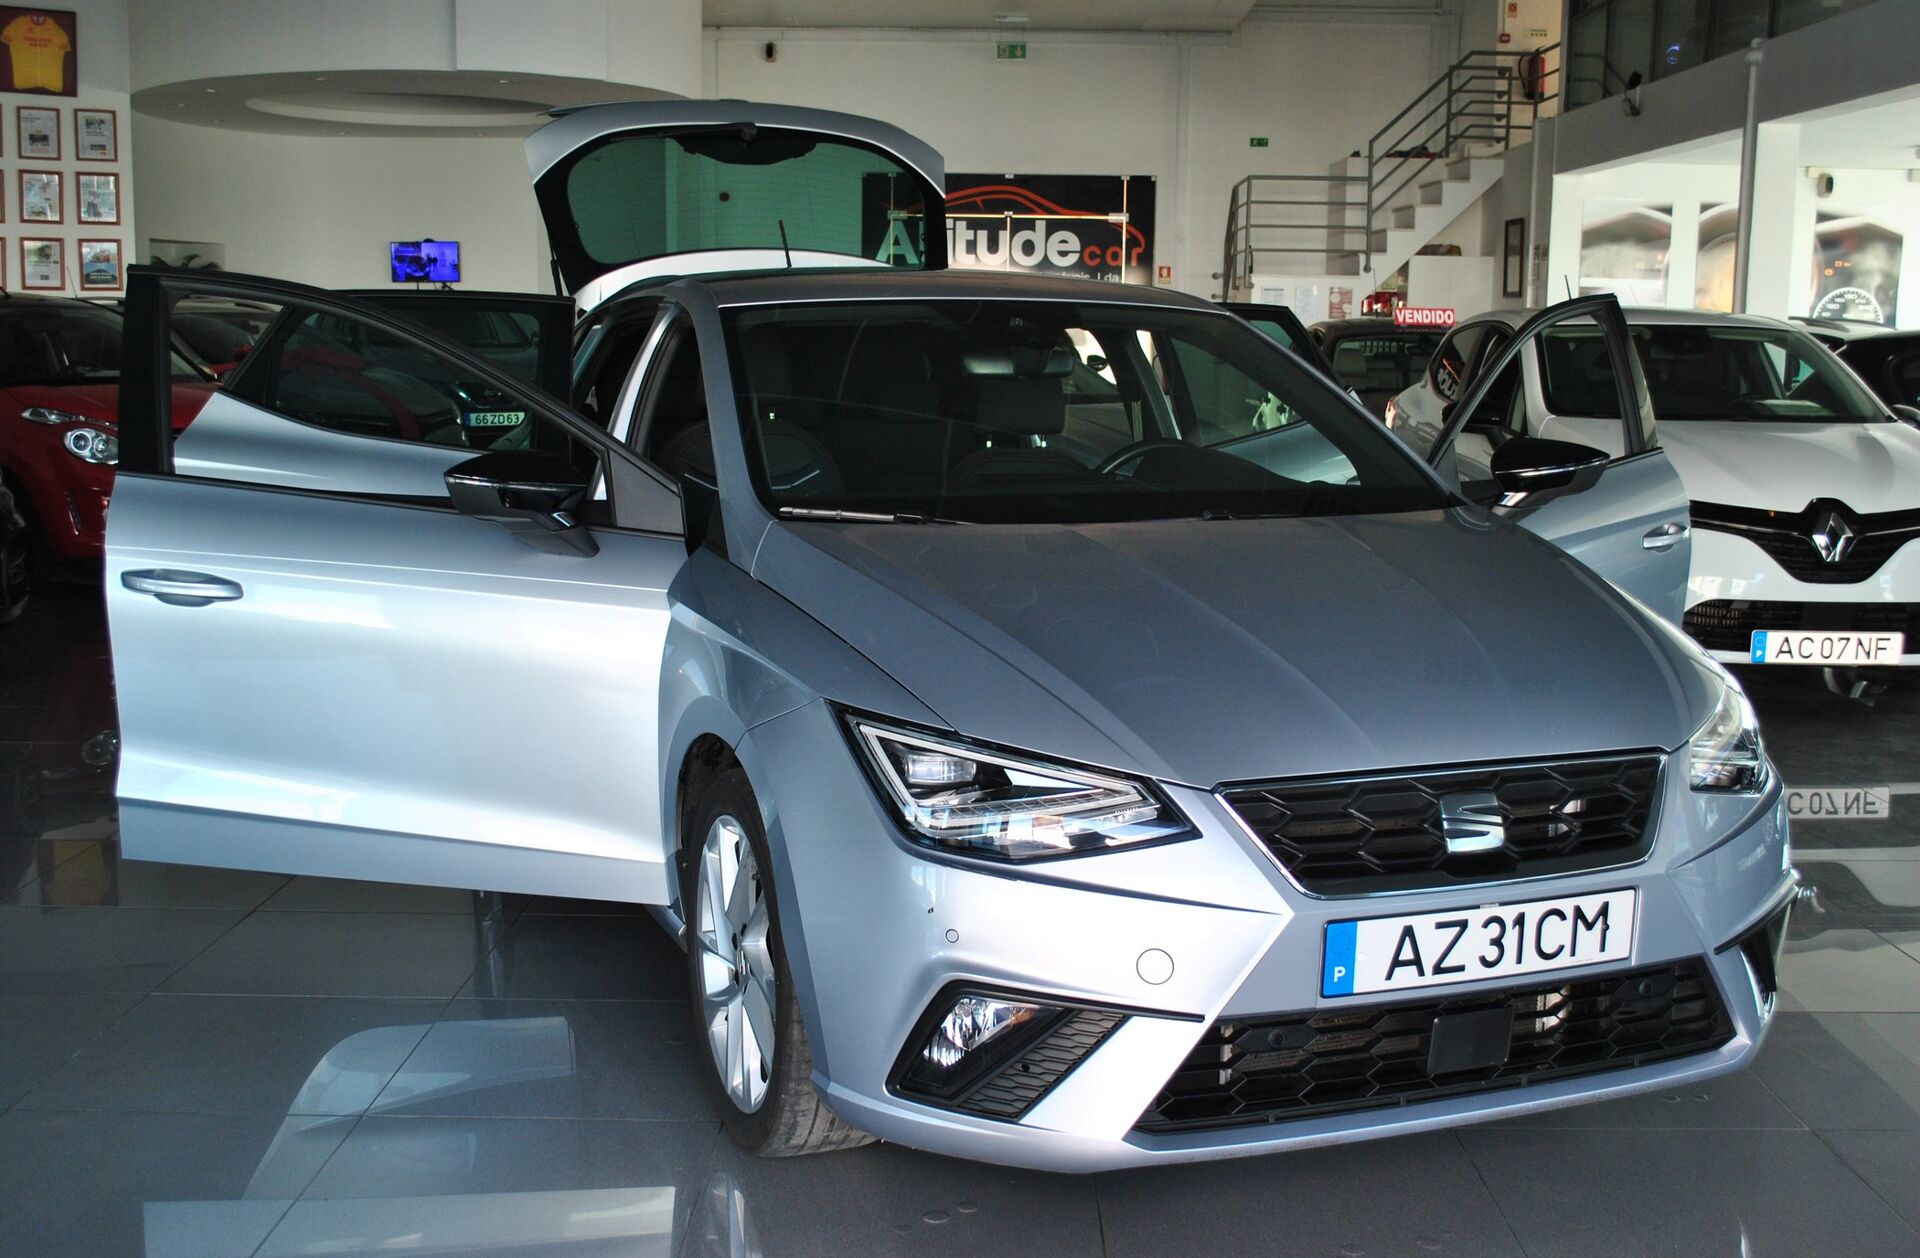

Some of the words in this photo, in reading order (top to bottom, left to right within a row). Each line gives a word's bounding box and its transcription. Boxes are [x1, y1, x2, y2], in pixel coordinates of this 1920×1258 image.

[1395, 309, 1454, 324] VENDIDO
[1775, 636, 1891, 660] AC07NF
[1385, 901, 1610, 981] AZ31CM
[1333, 966, 1346, 982] P
